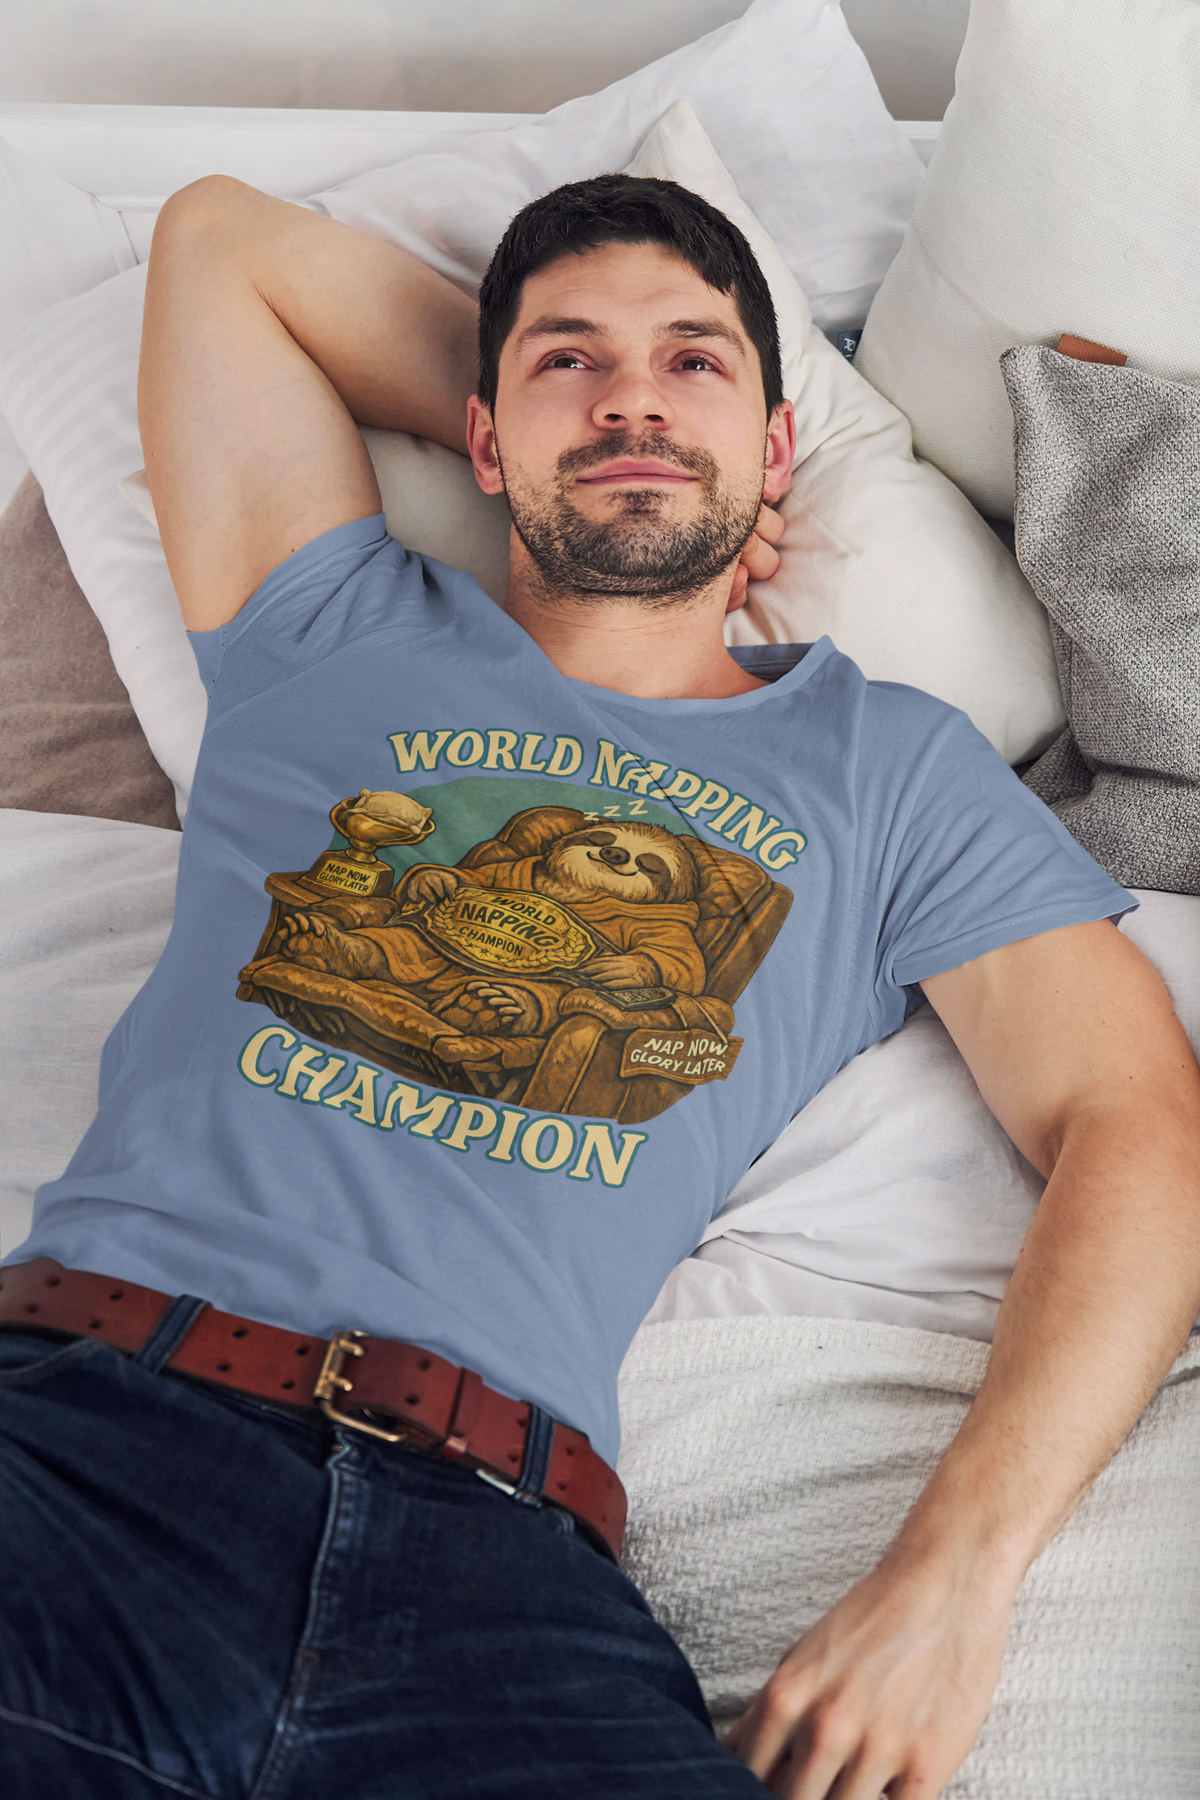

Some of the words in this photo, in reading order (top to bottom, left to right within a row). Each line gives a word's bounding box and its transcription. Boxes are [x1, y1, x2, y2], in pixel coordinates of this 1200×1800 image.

[389, 729, 582, 776] WORLD
[589, 740, 806, 870] NAPPING
[319, 871, 345, 885] GLORY
[343, 881, 370, 893] LATER
[325, 863, 348, 876] NAP
[346, 870, 371, 883] NOW
[460, 902, 560, 947] NAPPING
[490, 896, 557, 926] WORLD
[458, 926, 524, 957] CHAMPION
[643, 1038, 685, 1055] NAP
[630, 1049, 684, 1072] GLORY
[683, 1057, 726, 1075] LATER
[240, 1026, 642, 1185] CHAMPION
